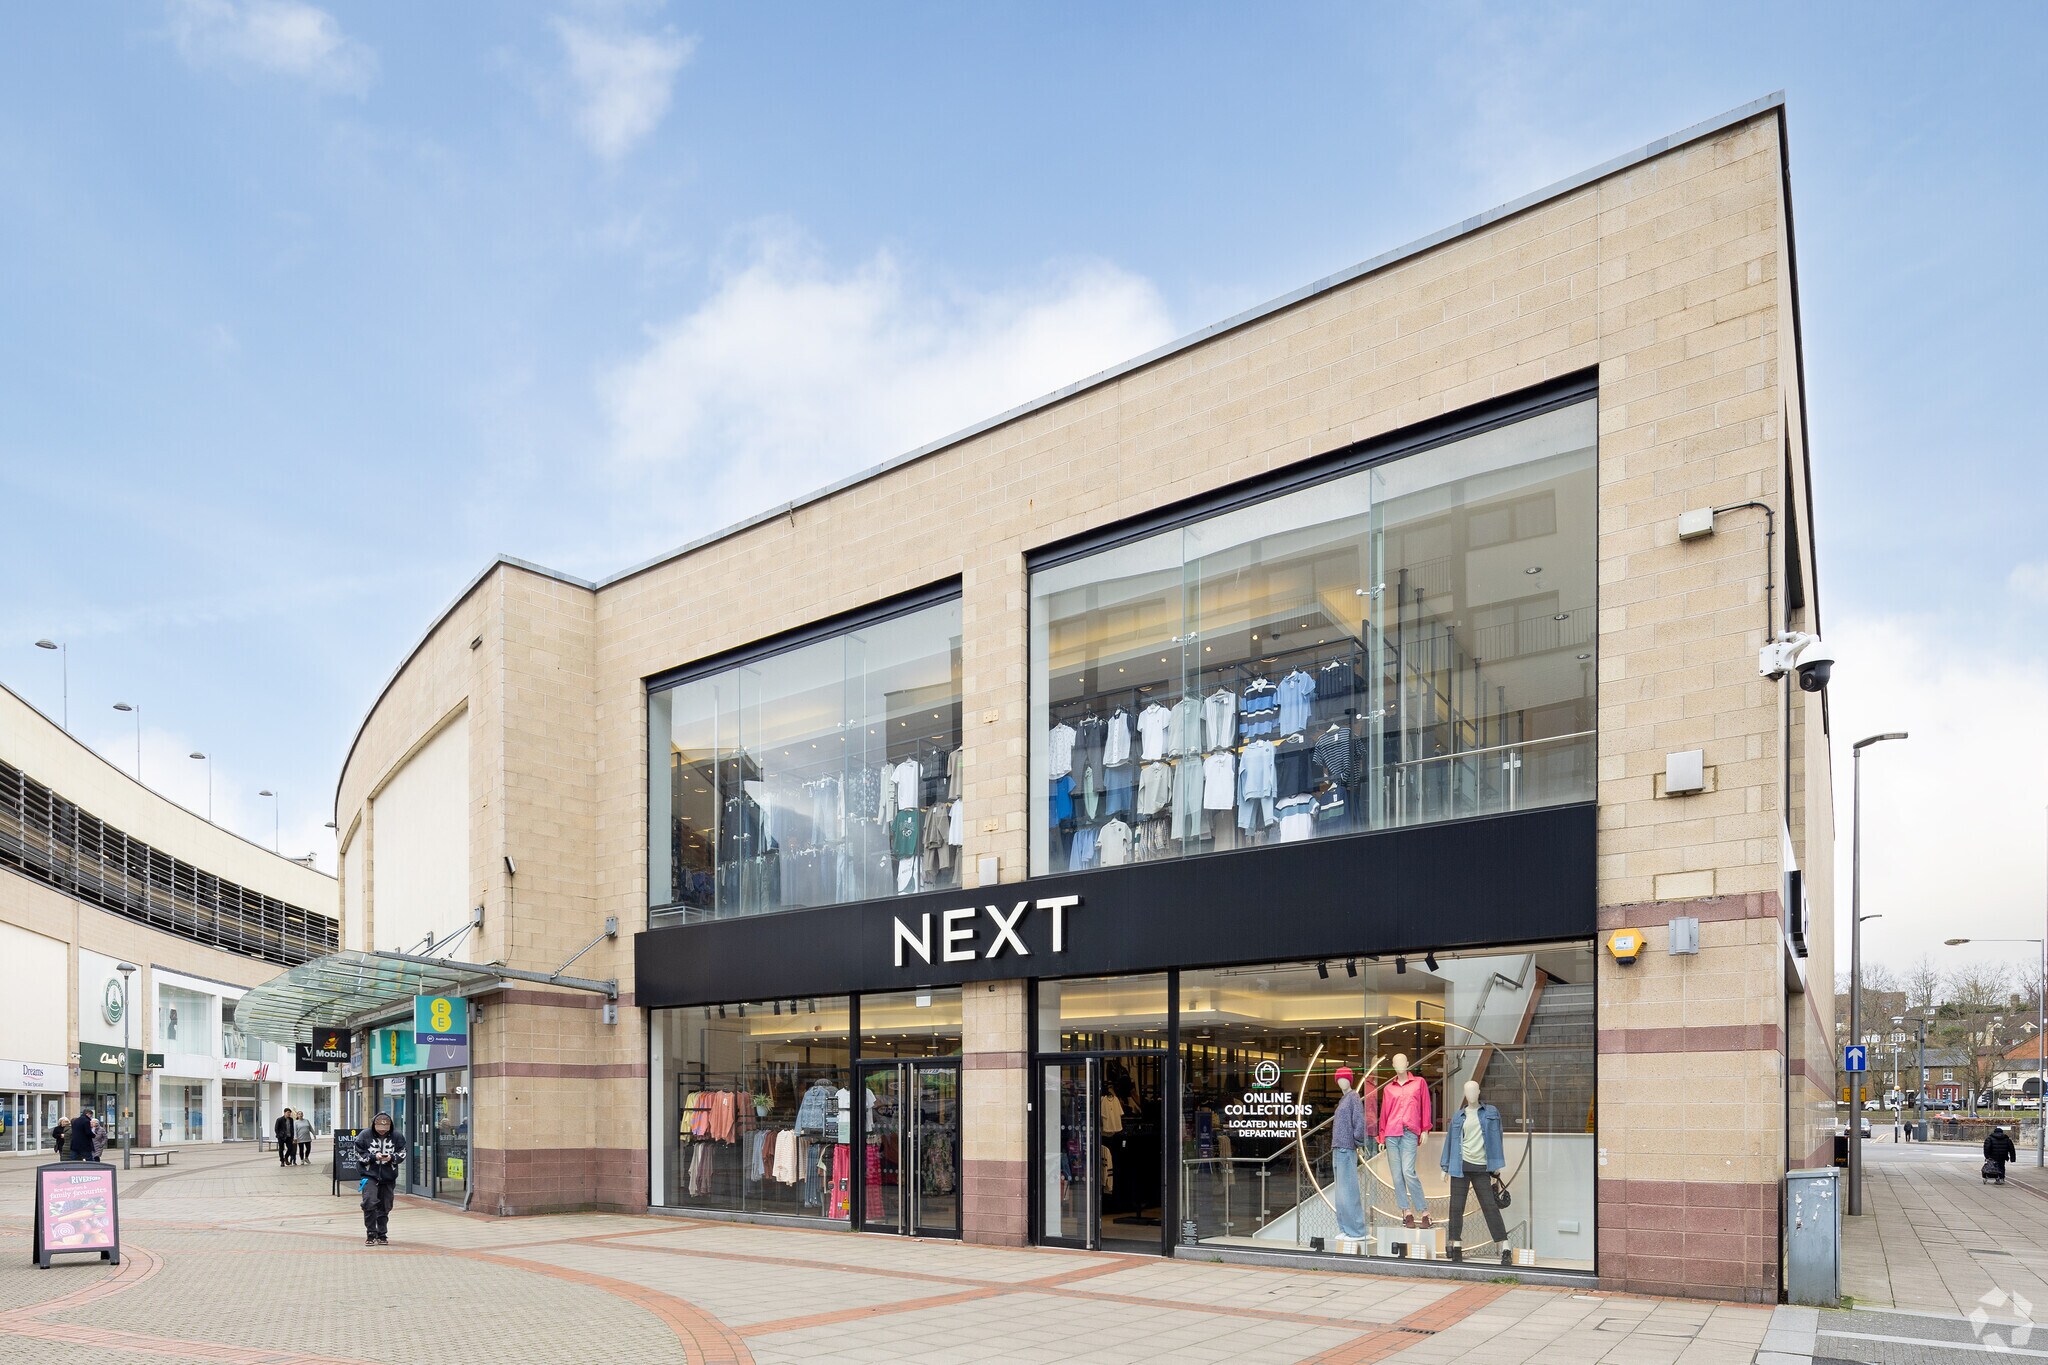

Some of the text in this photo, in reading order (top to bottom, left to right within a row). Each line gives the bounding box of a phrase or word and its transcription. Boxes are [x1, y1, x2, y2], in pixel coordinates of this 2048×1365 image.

[894, 895, 1079, 967] NEXT
[315, 1049, 348, 1058] Mobile
[23, 1064, 44, 1076] Dreams
[1243, 1092, 1292, 1103] ONLINE
[1224, 1104, 1312, 1115] COLLECTIONS
[1228, 1120, 1307, 1128] LOCATED IN MEN'S
[1239, 1129, 1297, 1138] DEPARTMENT
[49, 1187, 107, 1199] family favourites
